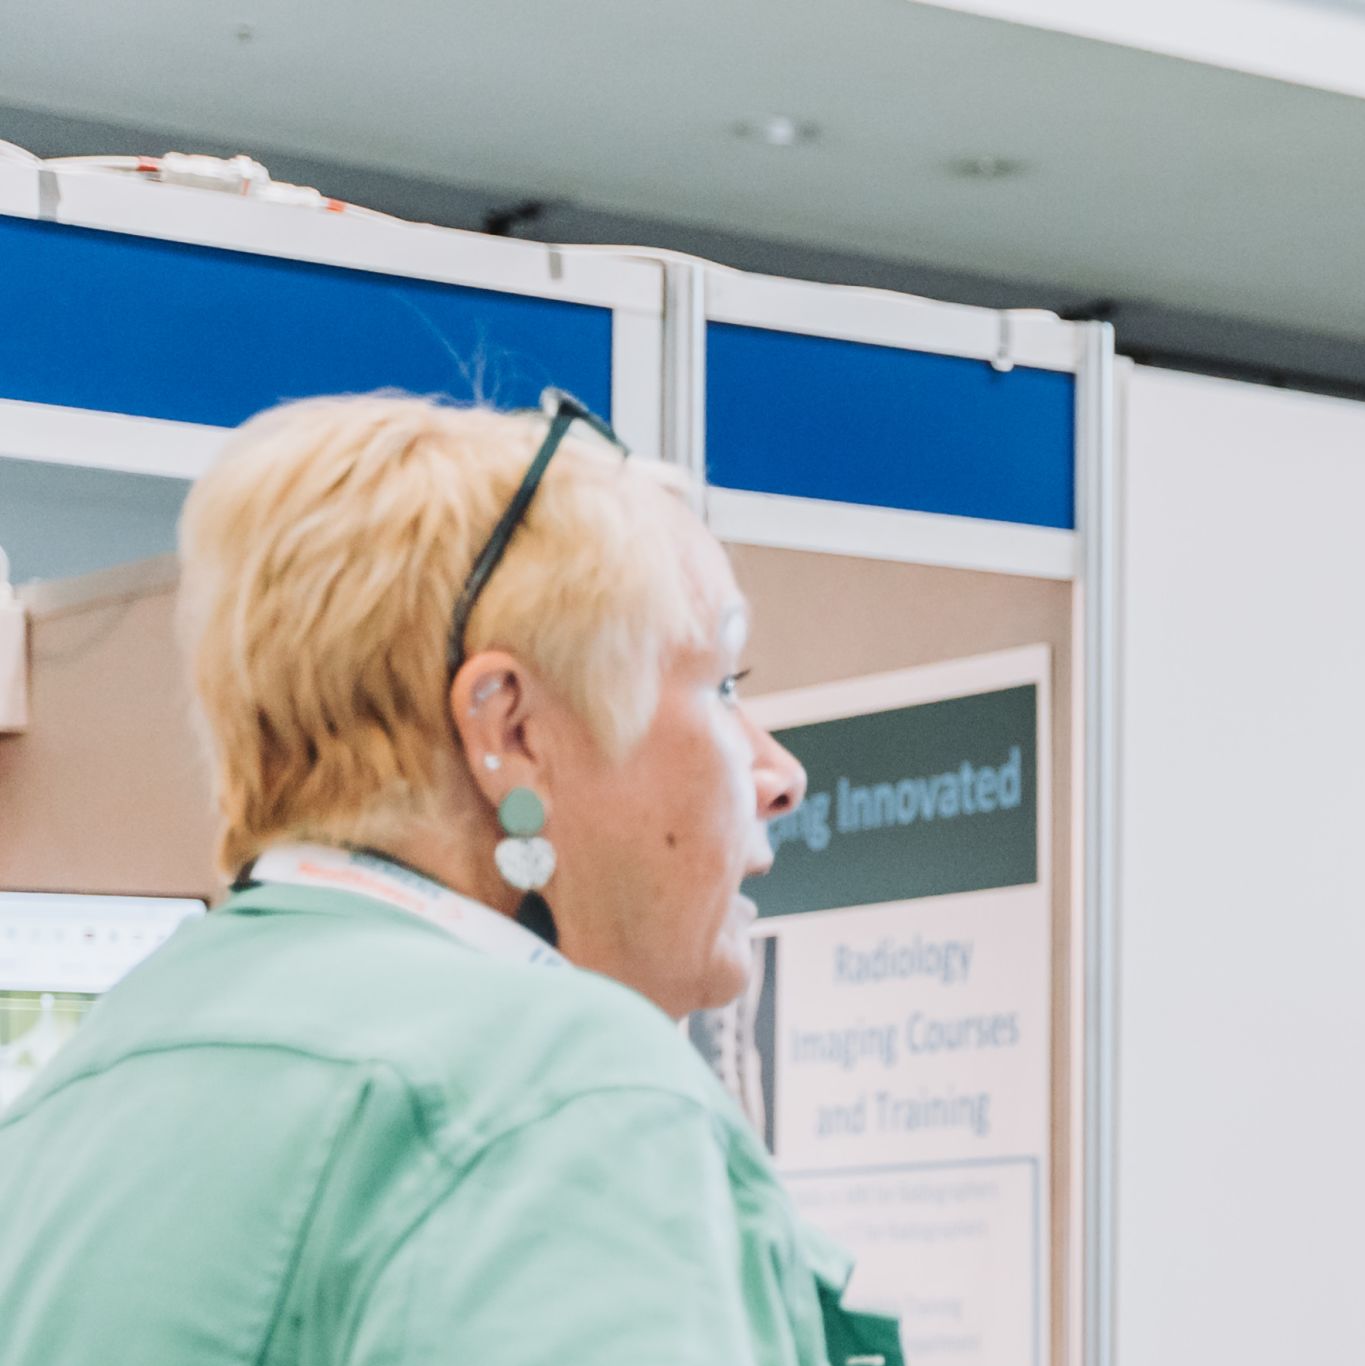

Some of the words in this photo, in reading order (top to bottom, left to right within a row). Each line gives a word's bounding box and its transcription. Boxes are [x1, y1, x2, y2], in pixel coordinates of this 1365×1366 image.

[837, 745, 1022, 833] Innovated
[835, 935, 973, 985] Radiology
[791, 1020, 897, 1071] Imaging
[906, 1010, 1018, 1055] Courses
[817, 1092, 866, 1138] and
[875, 1085, 991, 1137] Training
